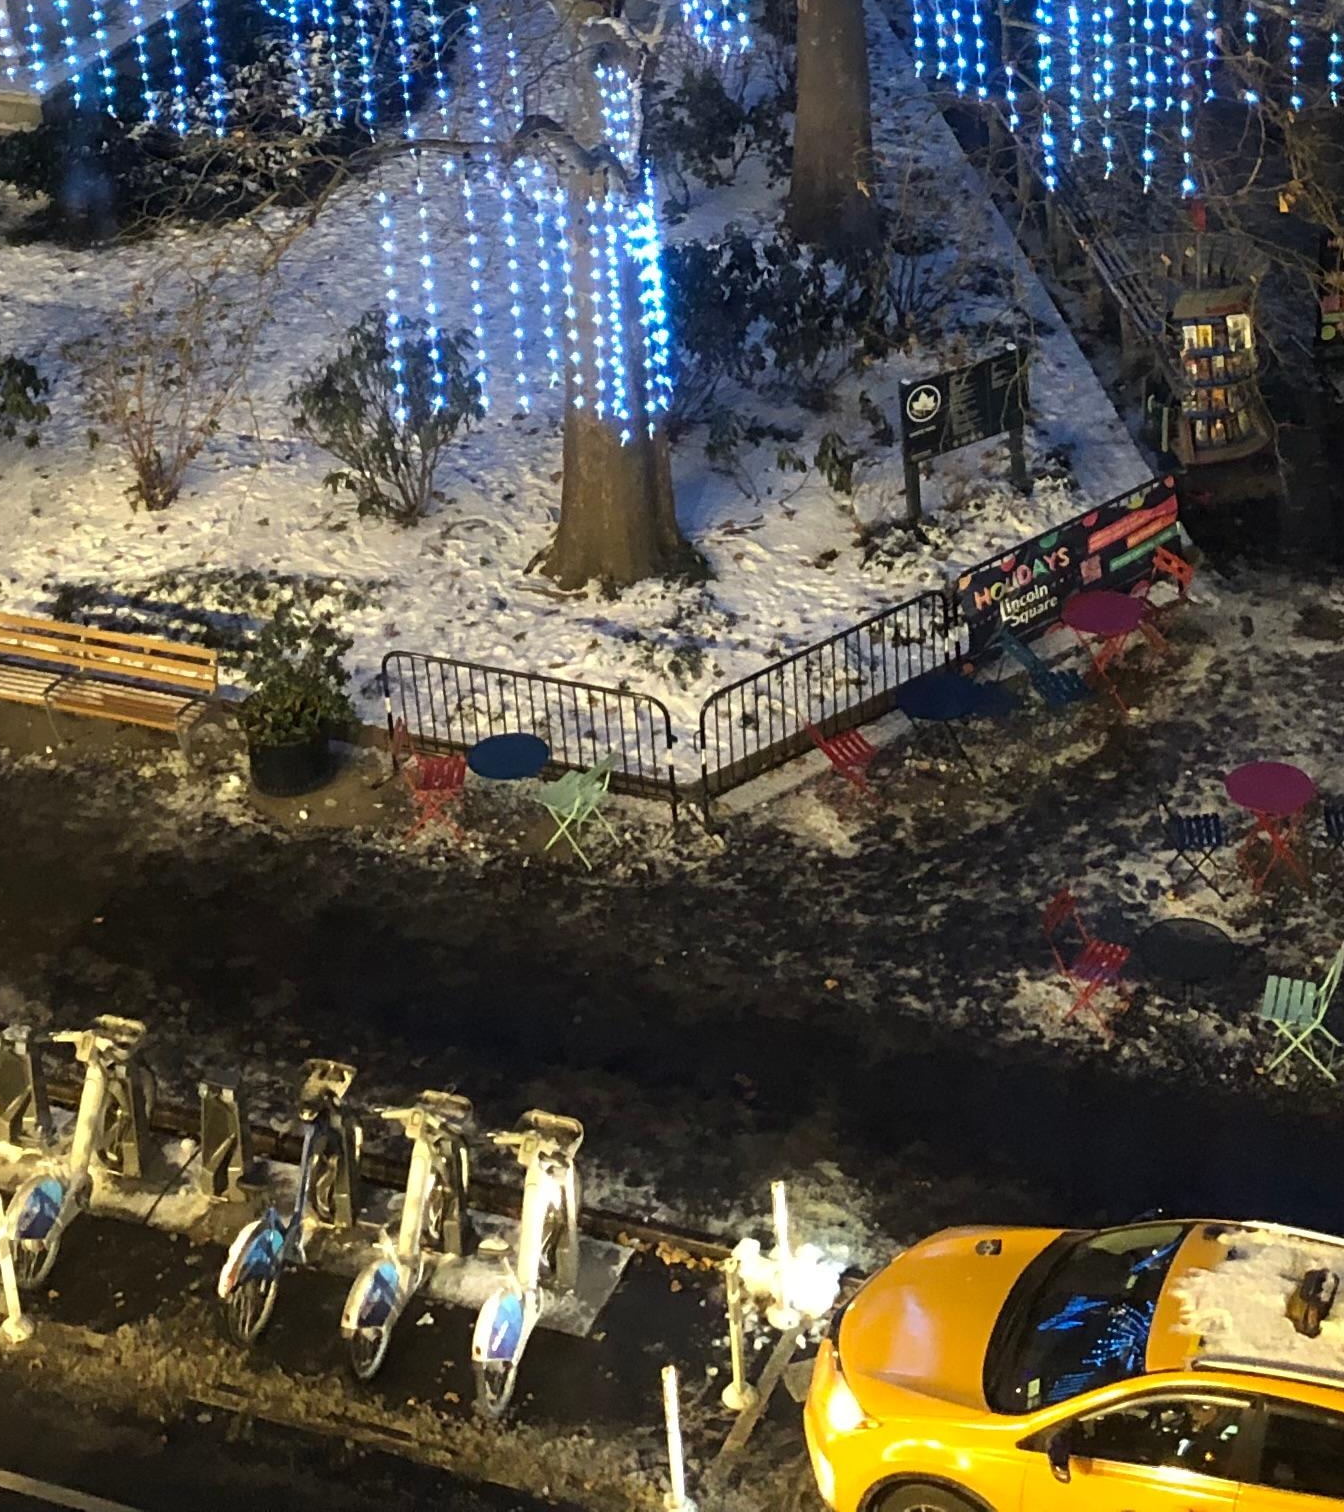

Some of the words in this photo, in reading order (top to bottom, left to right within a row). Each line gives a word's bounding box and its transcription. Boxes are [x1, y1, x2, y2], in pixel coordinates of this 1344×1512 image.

[974, 547, 1070, 610] HOLIDAYS
[1000, 585, 1048, 622] Lincoln
[1010, 596, 1058, 627] Square
